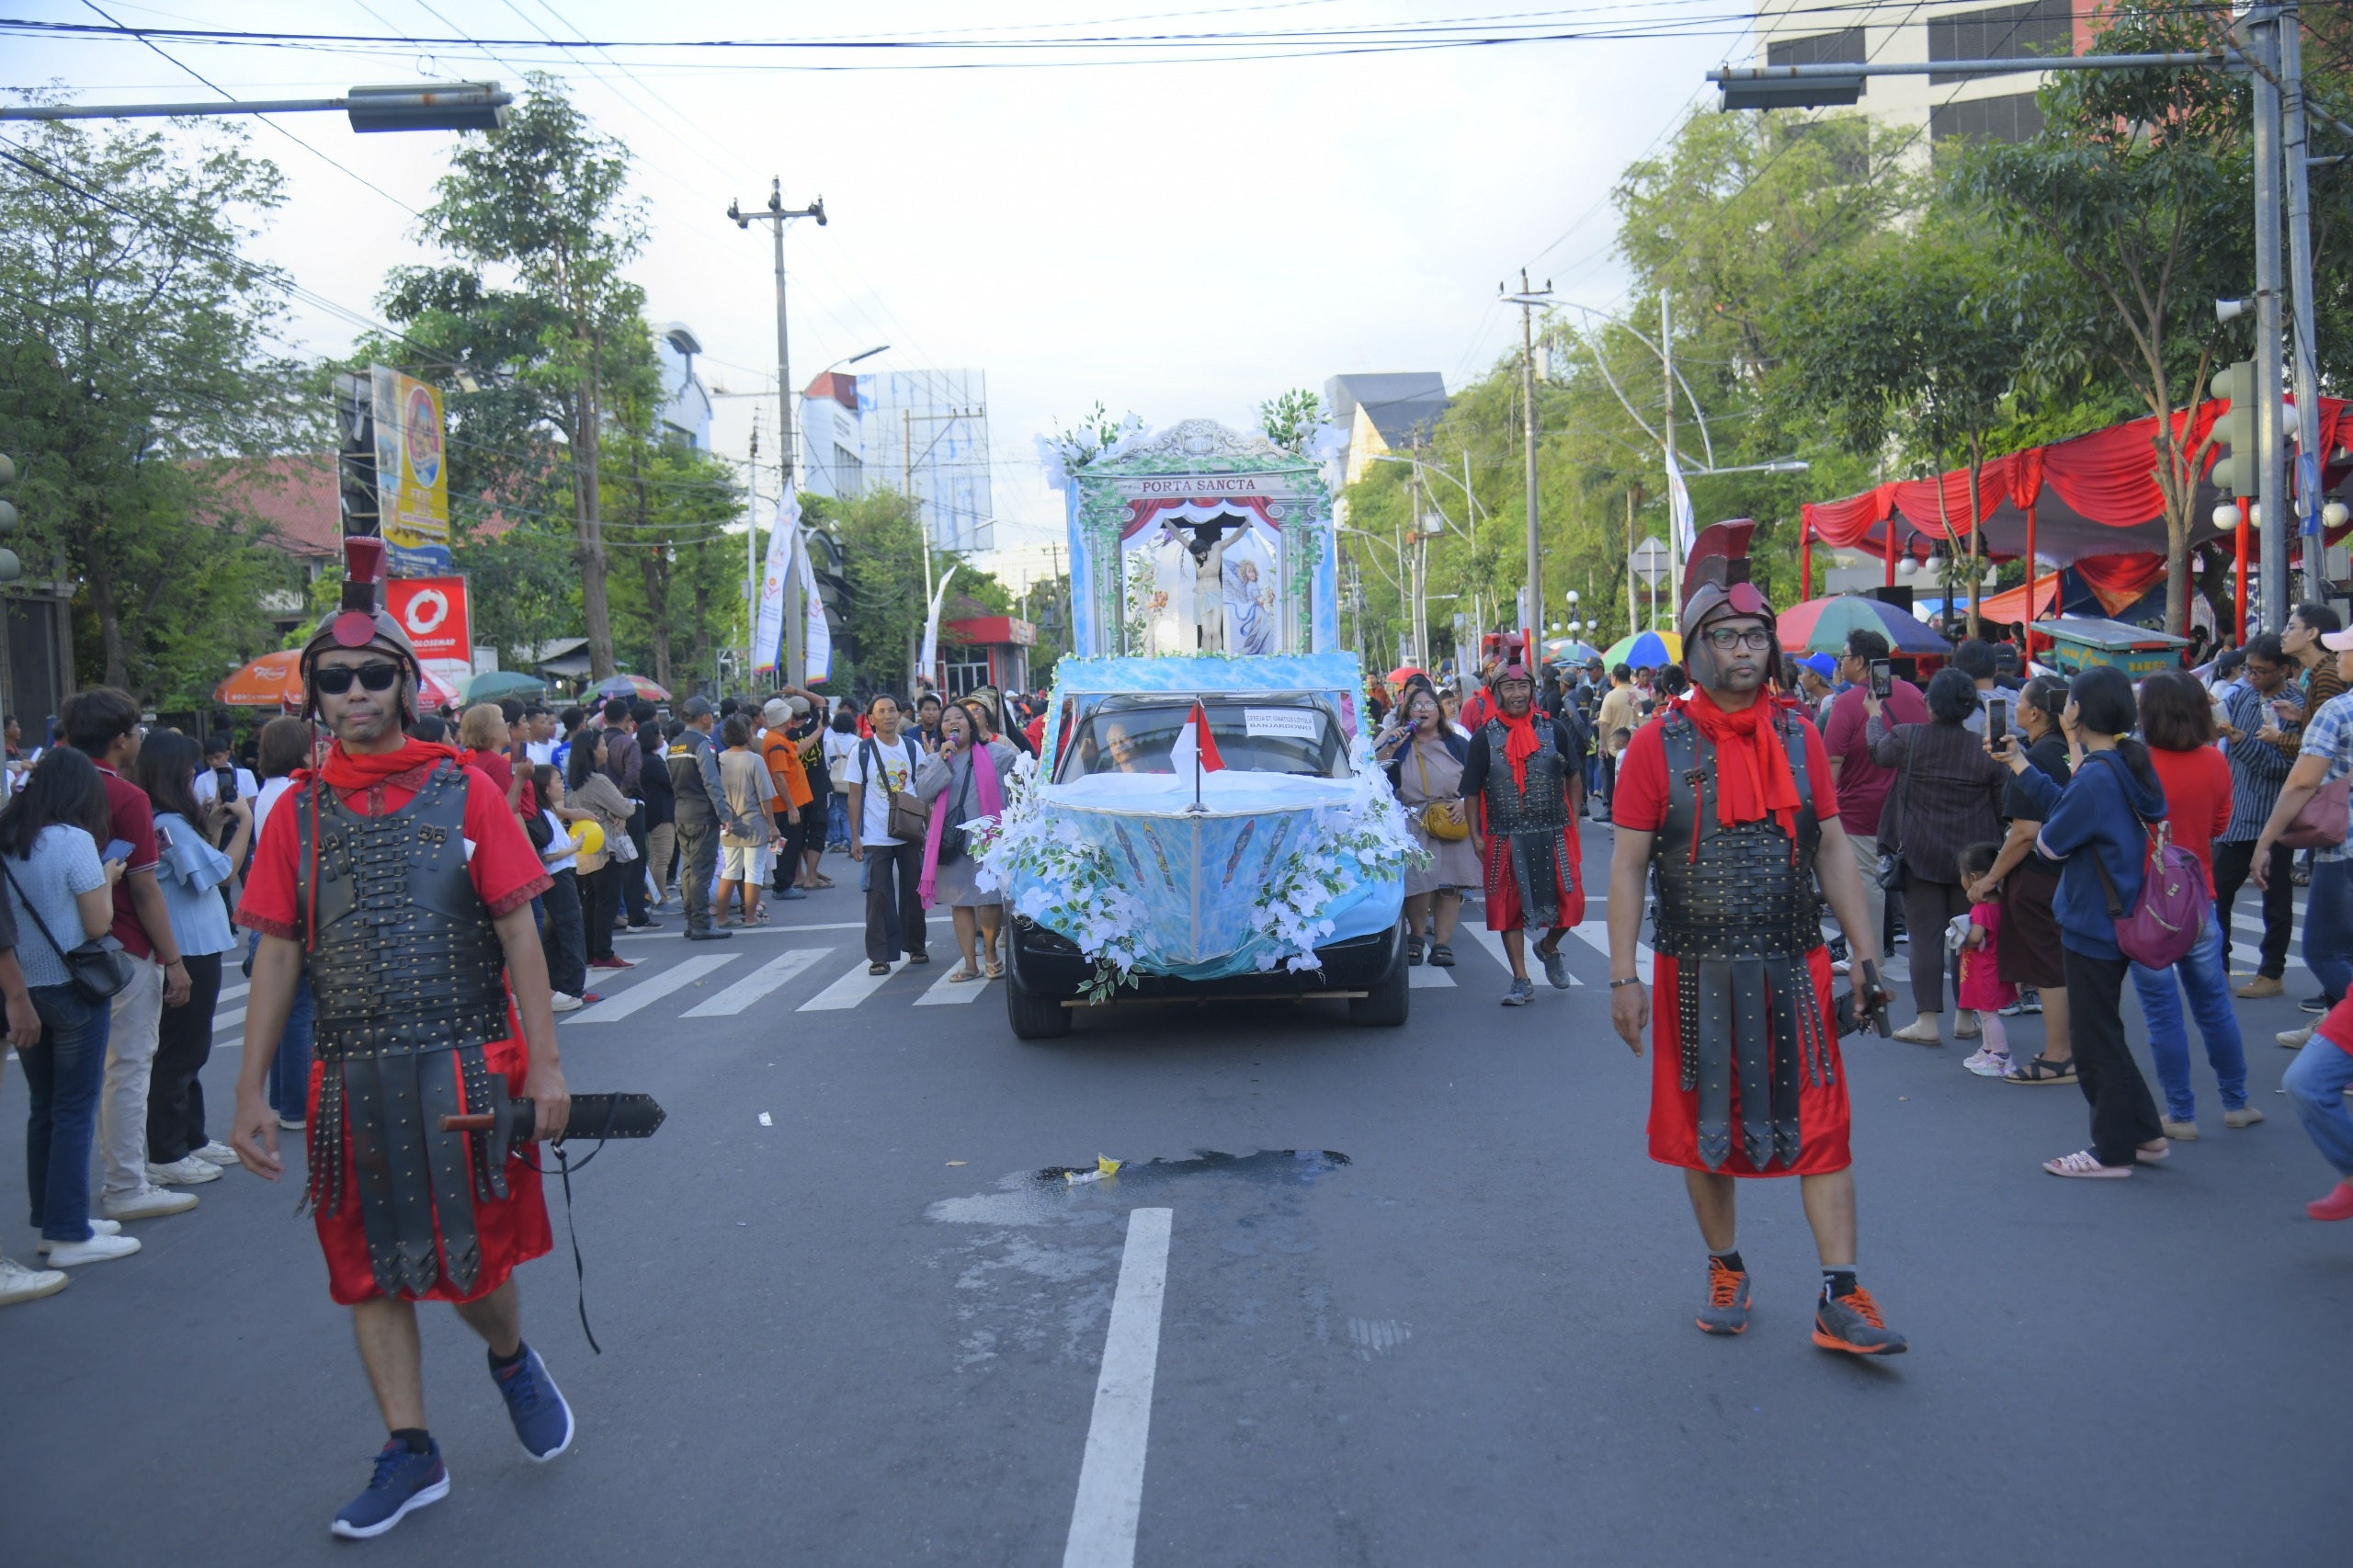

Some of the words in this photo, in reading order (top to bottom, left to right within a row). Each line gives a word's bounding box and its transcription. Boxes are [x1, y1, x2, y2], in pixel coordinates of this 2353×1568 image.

[1142, 481, 1192, 493] PORTA
[1197, 479, 1256, 490] SANCTA
[410, 488, 433, 516] TIC
[2129, 661, 2166, 672] BAKSO
